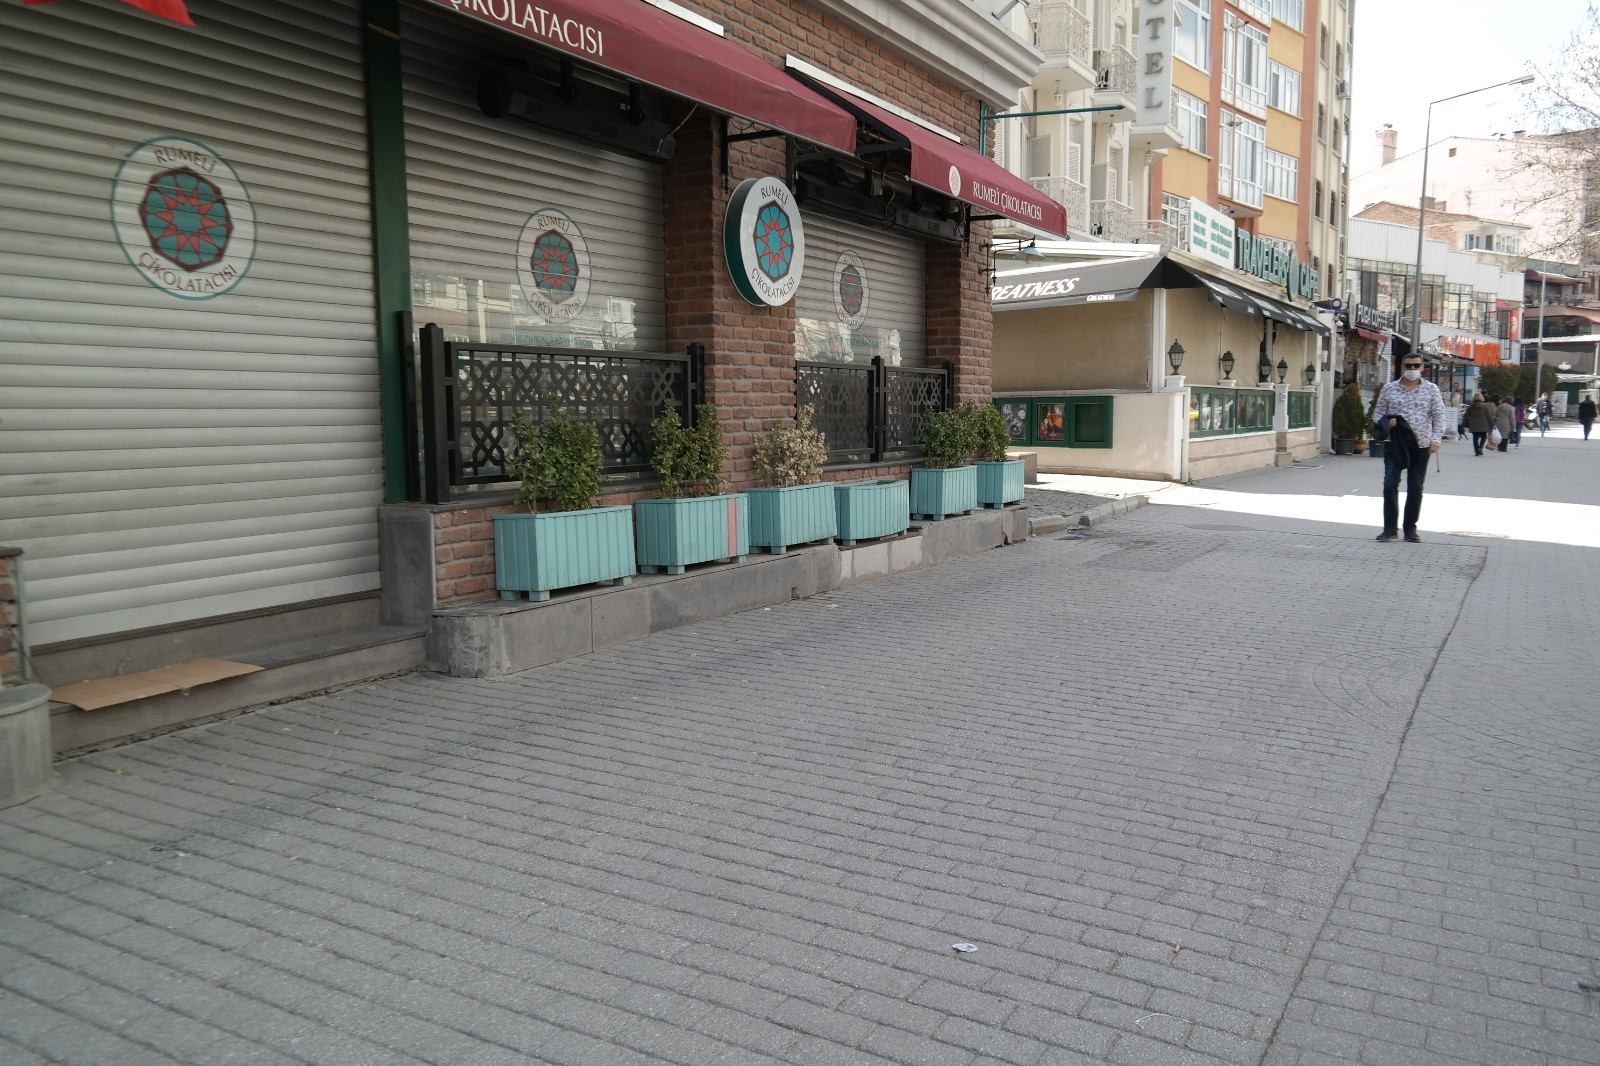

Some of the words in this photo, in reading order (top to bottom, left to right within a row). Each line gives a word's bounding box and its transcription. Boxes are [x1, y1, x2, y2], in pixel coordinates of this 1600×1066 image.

[452, 0, 603, 56] OLATACISI
[1144, 0, 1166, 109] TEL
[154, 147, 217, 173] RUMELİ
[760, 186, 789, 204] RUMELİ
[973, 181, 1000, 205] RUMELİ
[1001, 191, 1042, 220] ÇİKOLATACISI
[537, 216, 570, 232] RUMELİ
[991, 278, 1080, 300] REATNESS
